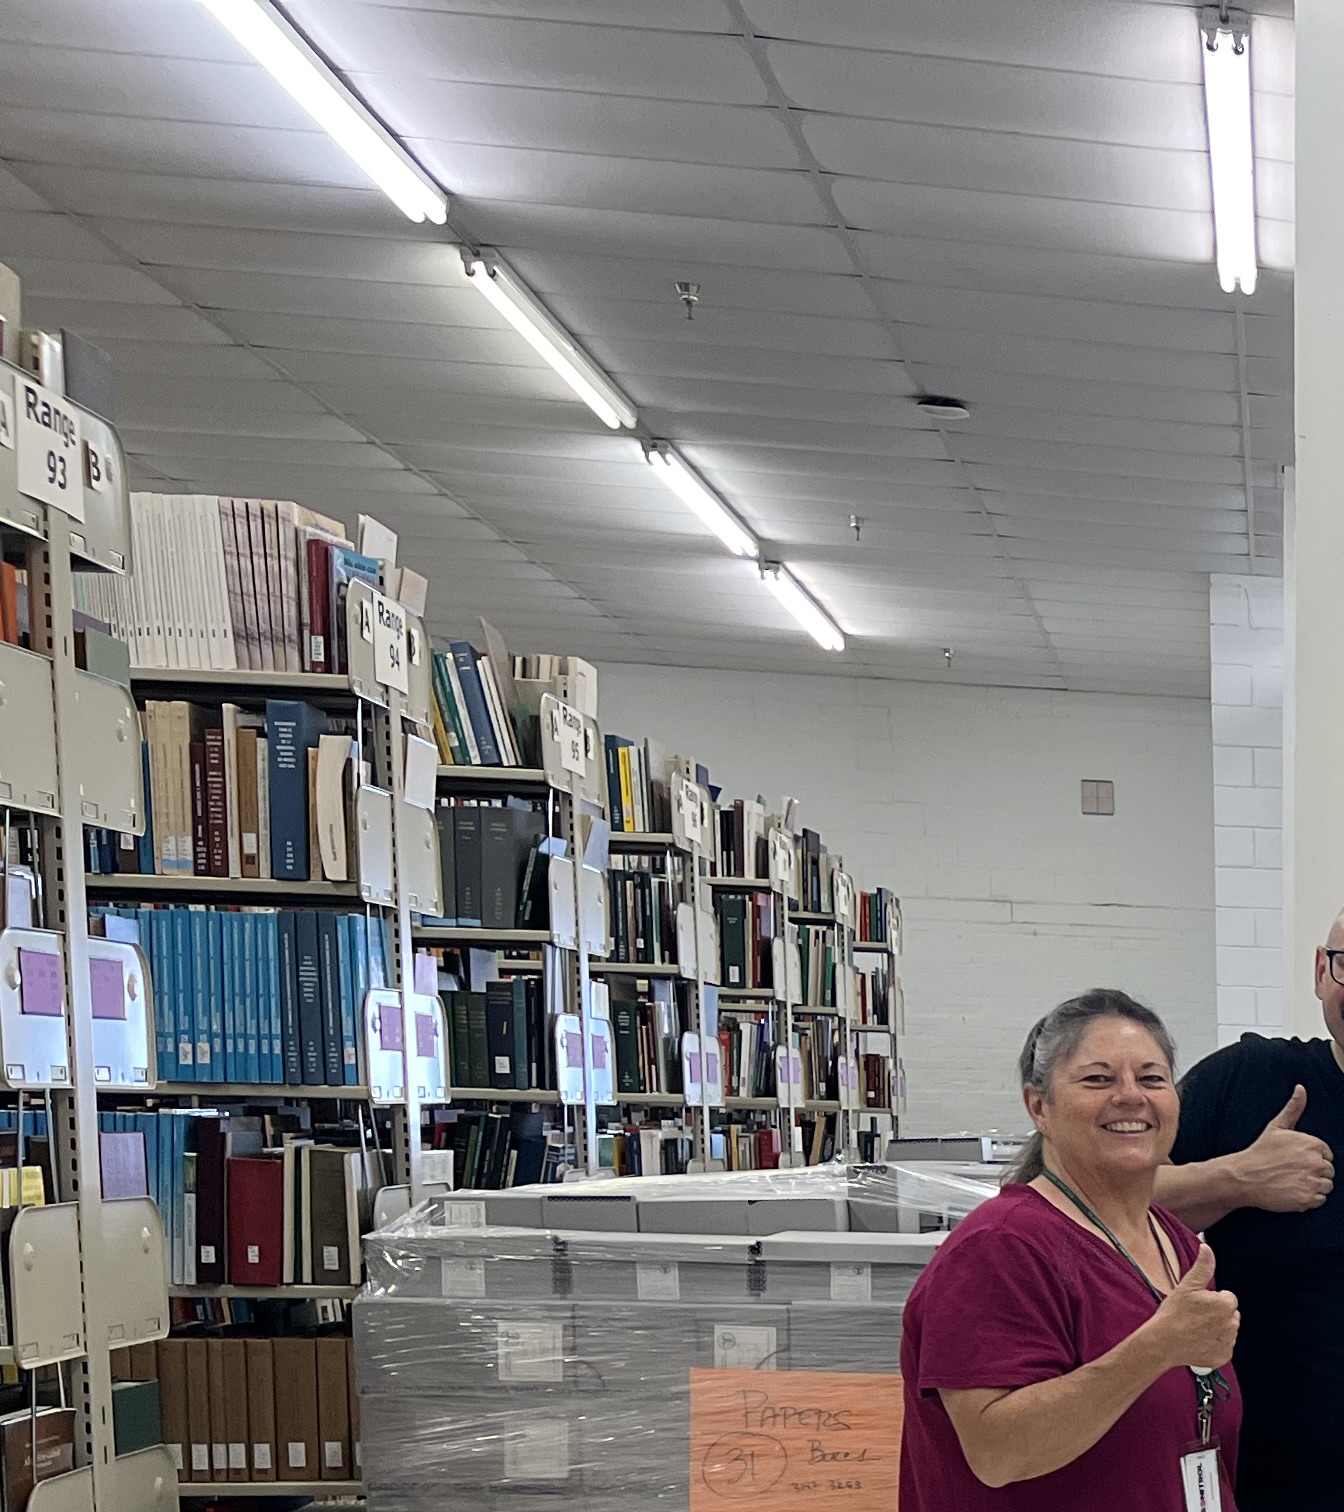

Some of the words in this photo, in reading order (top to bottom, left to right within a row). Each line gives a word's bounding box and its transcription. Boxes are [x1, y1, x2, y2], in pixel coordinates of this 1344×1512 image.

[23, 384, 77, 449] Range
[46, 449, 68, 491] 93
[88, 446, 102, 483] B
[363, 608, 371, 634] A
[377, 599, 404, 641] Range
[389, 643, 401, 672] 94
[737, 1388, 855, 1432] PAPERS
[725, 1446, 757, 1486] 31
